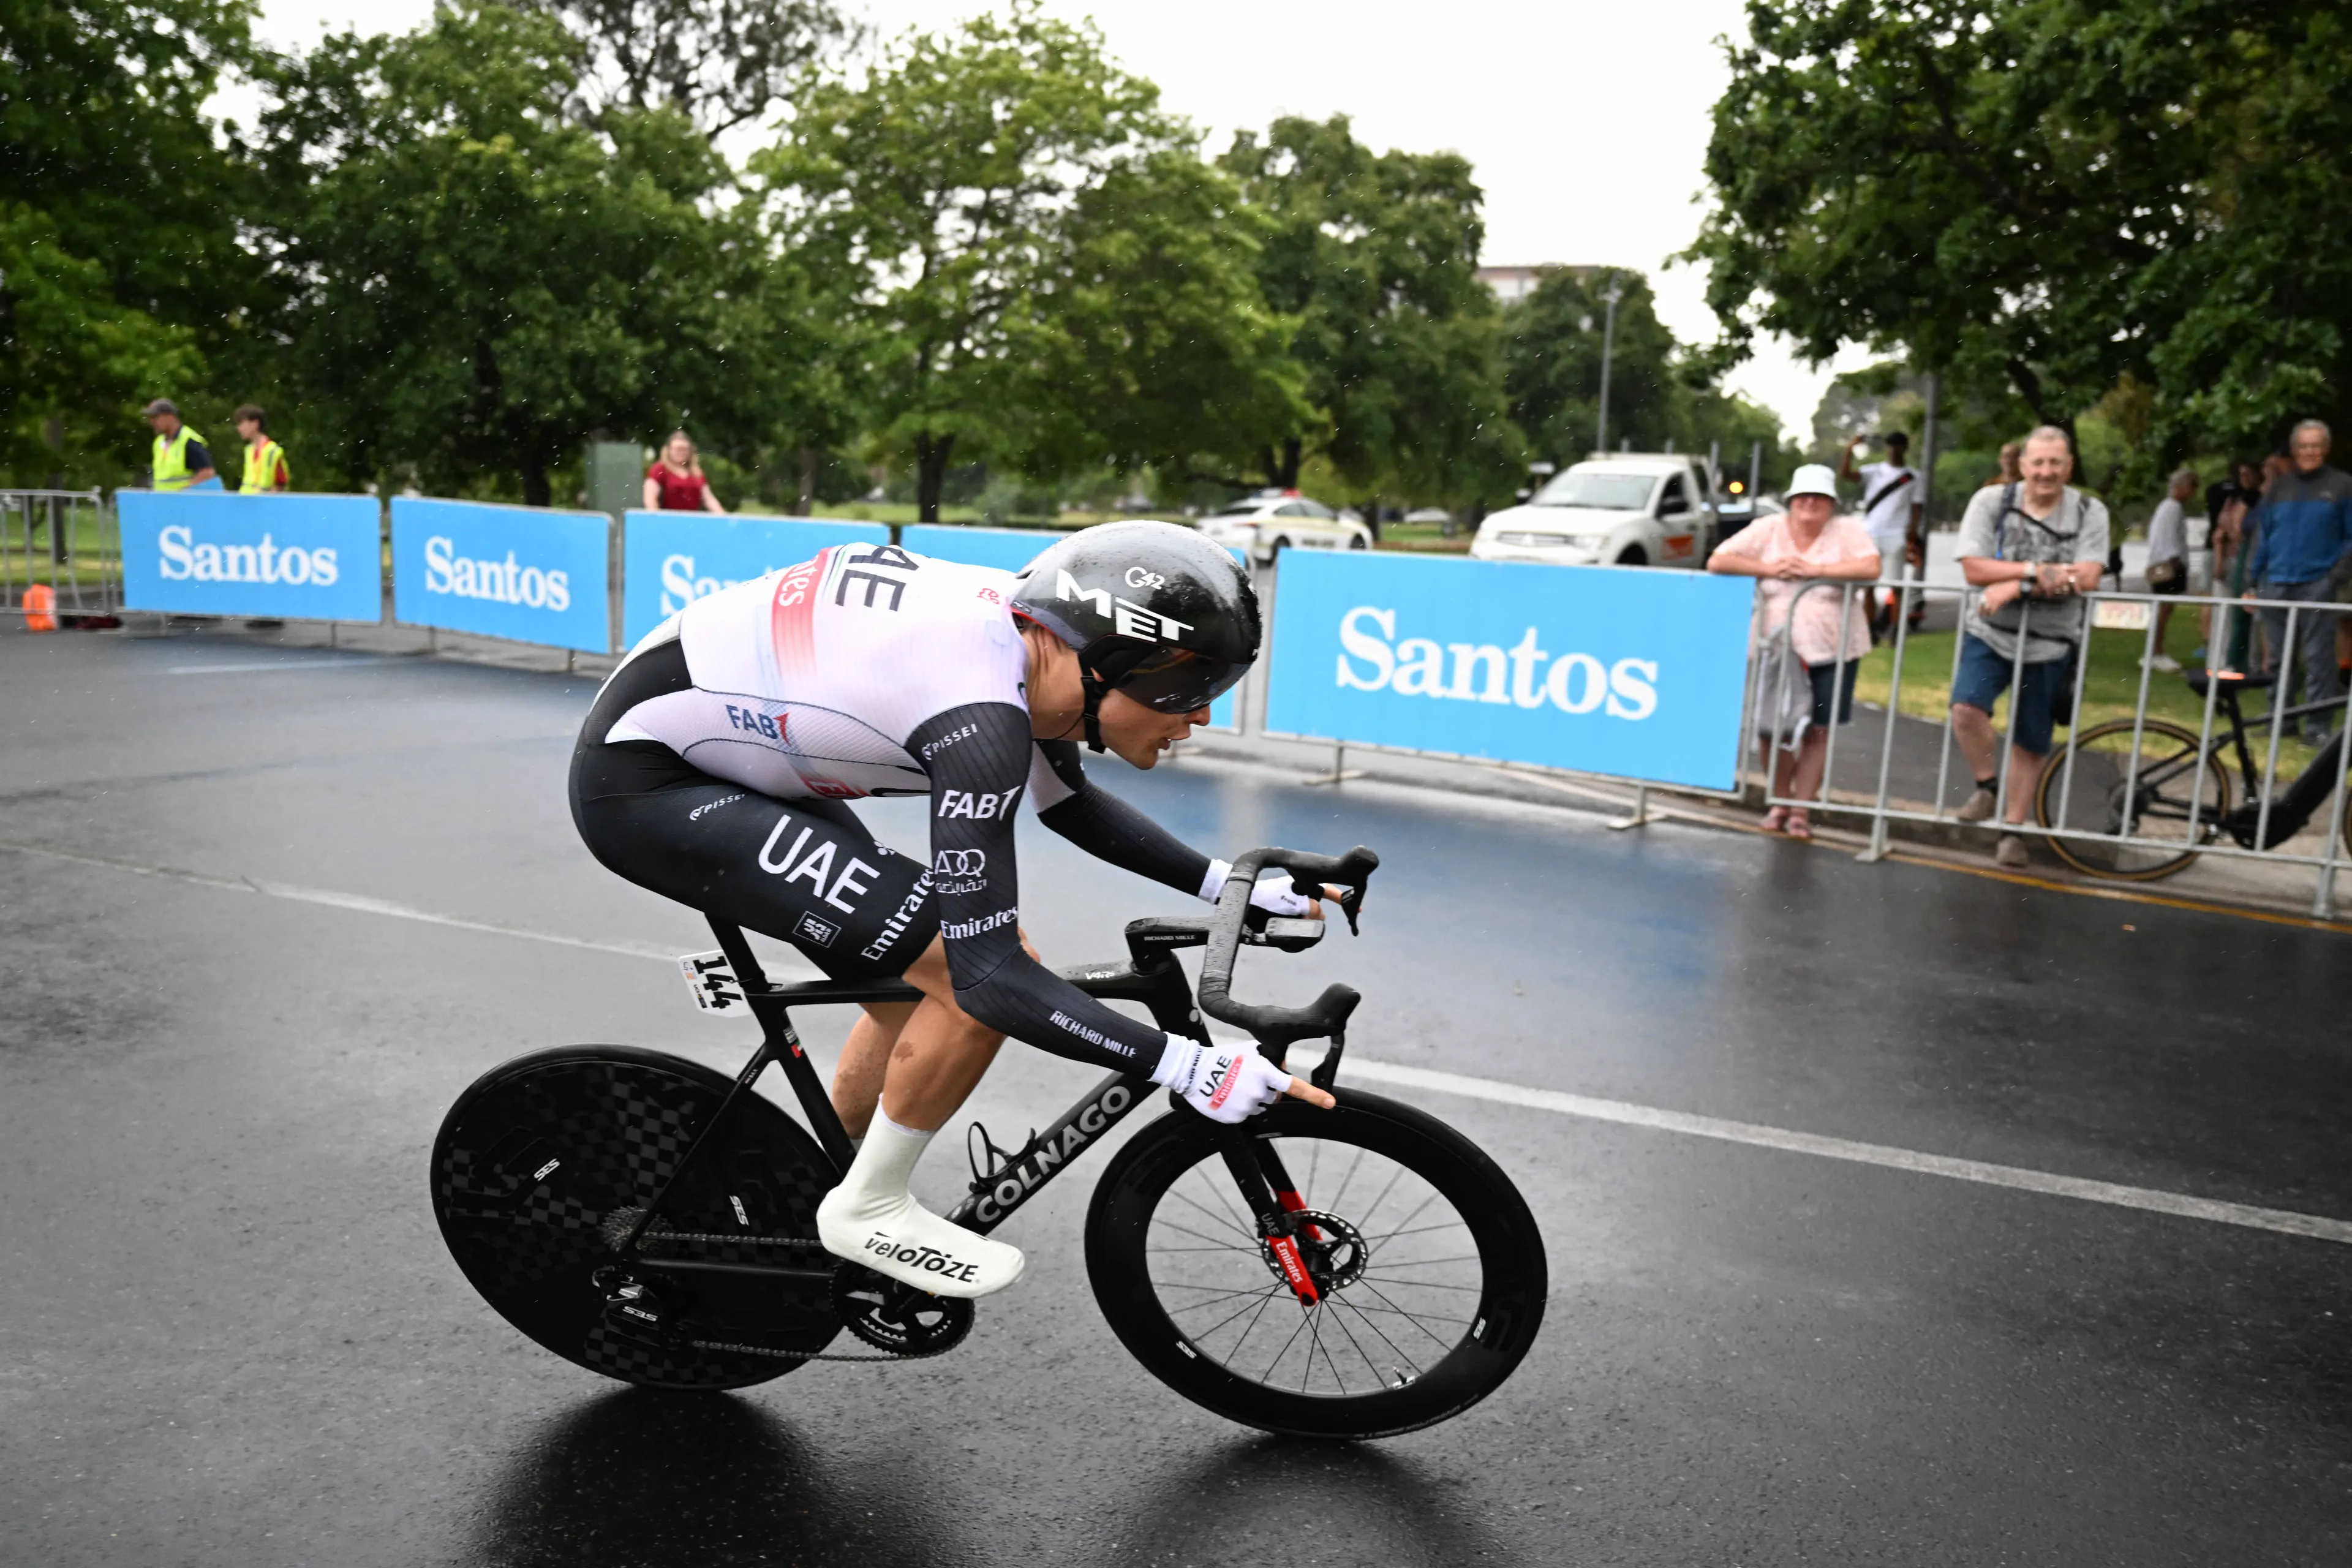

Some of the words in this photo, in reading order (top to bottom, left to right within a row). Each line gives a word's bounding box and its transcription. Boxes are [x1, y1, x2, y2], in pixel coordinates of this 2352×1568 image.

[159, 525, 338, 586] Santos
[424, 536, 570, 611] Santos
[835, 545, 919, 611] AE
[1125, 567, 1165, 590] G42
[1056, 568, 1194, 643] MET
[1336, 605, 1658, 721] Santos
[932, 723, 978, 753] PISSEI
[758, 814, 881, 914] UAE
[934, 849, 986, 877] ADQ
[940, 907, 1019, 939] Emirates
[693, 956, 743, 1009] 144
[1049, 1010, 1104, 1045] RICHARD
[1102, 1037, 1137, 1058] MILLE
[1199, 1055, 1232, 1097] UAE
[533, 1158, 560, 1182] SES
[976, 1086, 1131, 1223] COLNAGO
[729, 1195, 749, 1226] SES
[1262, 1213, 1280, 1235] UAE
[1276, 1241, 1303, 1283] Emirates
